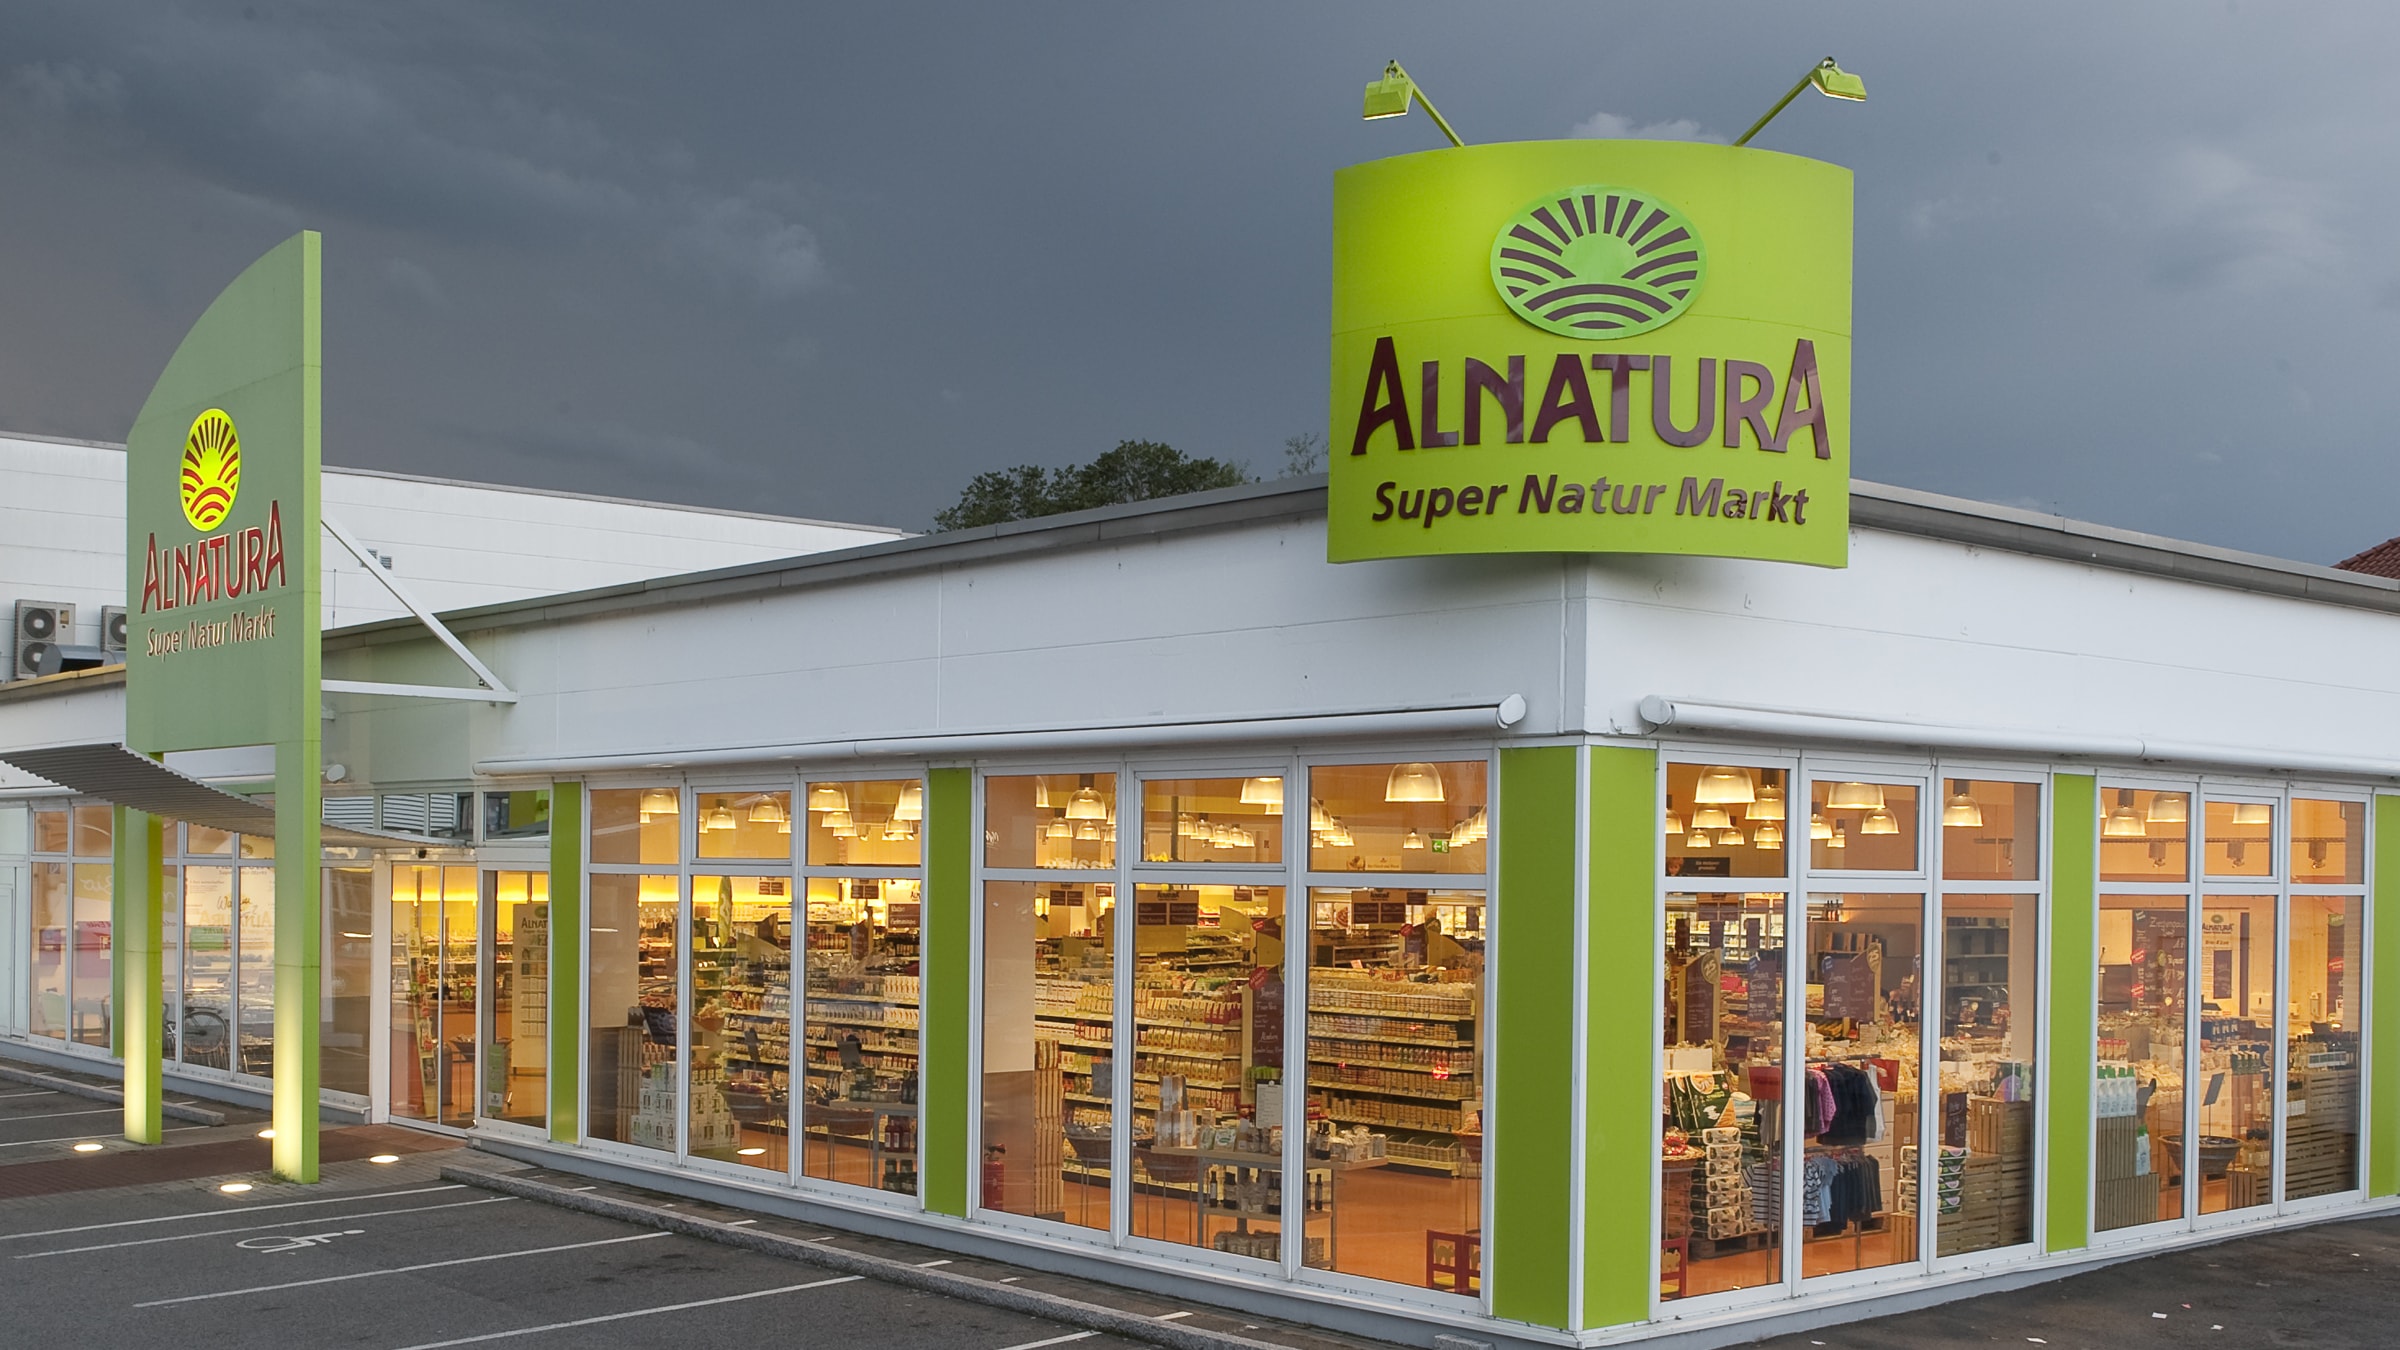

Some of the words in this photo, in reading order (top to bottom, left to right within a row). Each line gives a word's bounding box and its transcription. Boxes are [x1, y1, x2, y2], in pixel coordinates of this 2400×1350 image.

[1350, 336, 1831, 459] ALNATURA
[1372, 480, 1508, 529] Super
[1518, 473, 1666, 515] Natur
[1676, 476, 1810, 526] Markt
[142, 500, 286, 614] ALNATURA
[147, 627, 185, 662] Super
[188, 619, 228, 650] Natur
[231, 606, 276, 643] Markt
